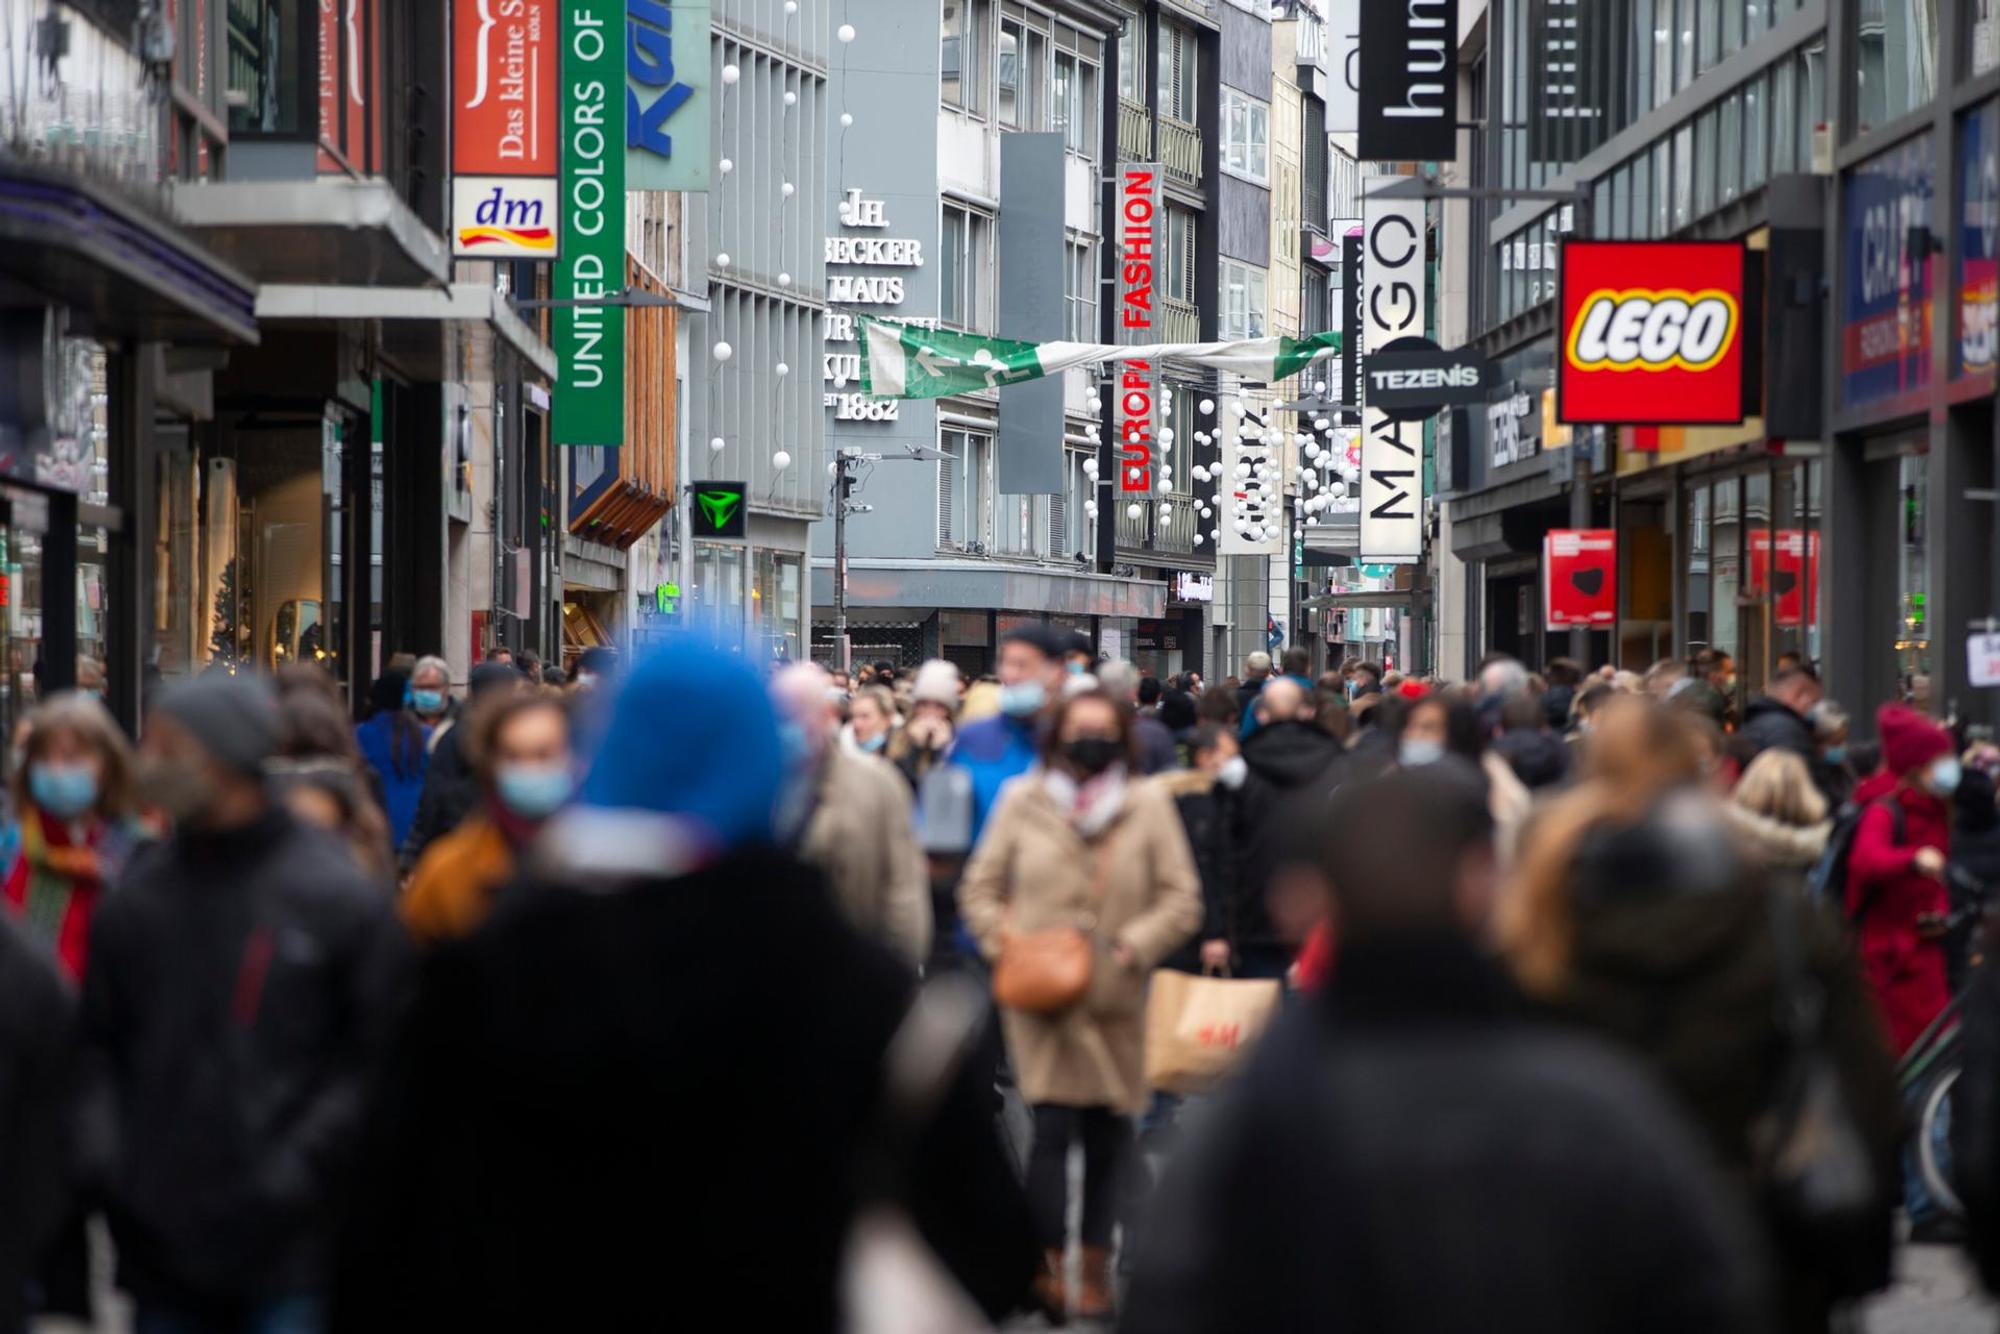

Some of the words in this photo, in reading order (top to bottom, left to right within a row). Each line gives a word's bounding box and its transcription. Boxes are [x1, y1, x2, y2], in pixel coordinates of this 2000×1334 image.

[529, 5, 541, 42] KÖLN
[573, 8, 605, 60] OF
[499, 25, 524, 102] kleine
[499, 108, 524, 160] Das
[573, 81, 605, 236] COLORS
[475, 187, 544, 226] dm
[1123, 171, 1153, 328] FASHION
[573, 254, 604, 388] UNITED
[827, 275, 905, 304] HAUS
[1574, 296, 1731, 364] LEGO
[1370, 214, 1417, 520] MAGO
